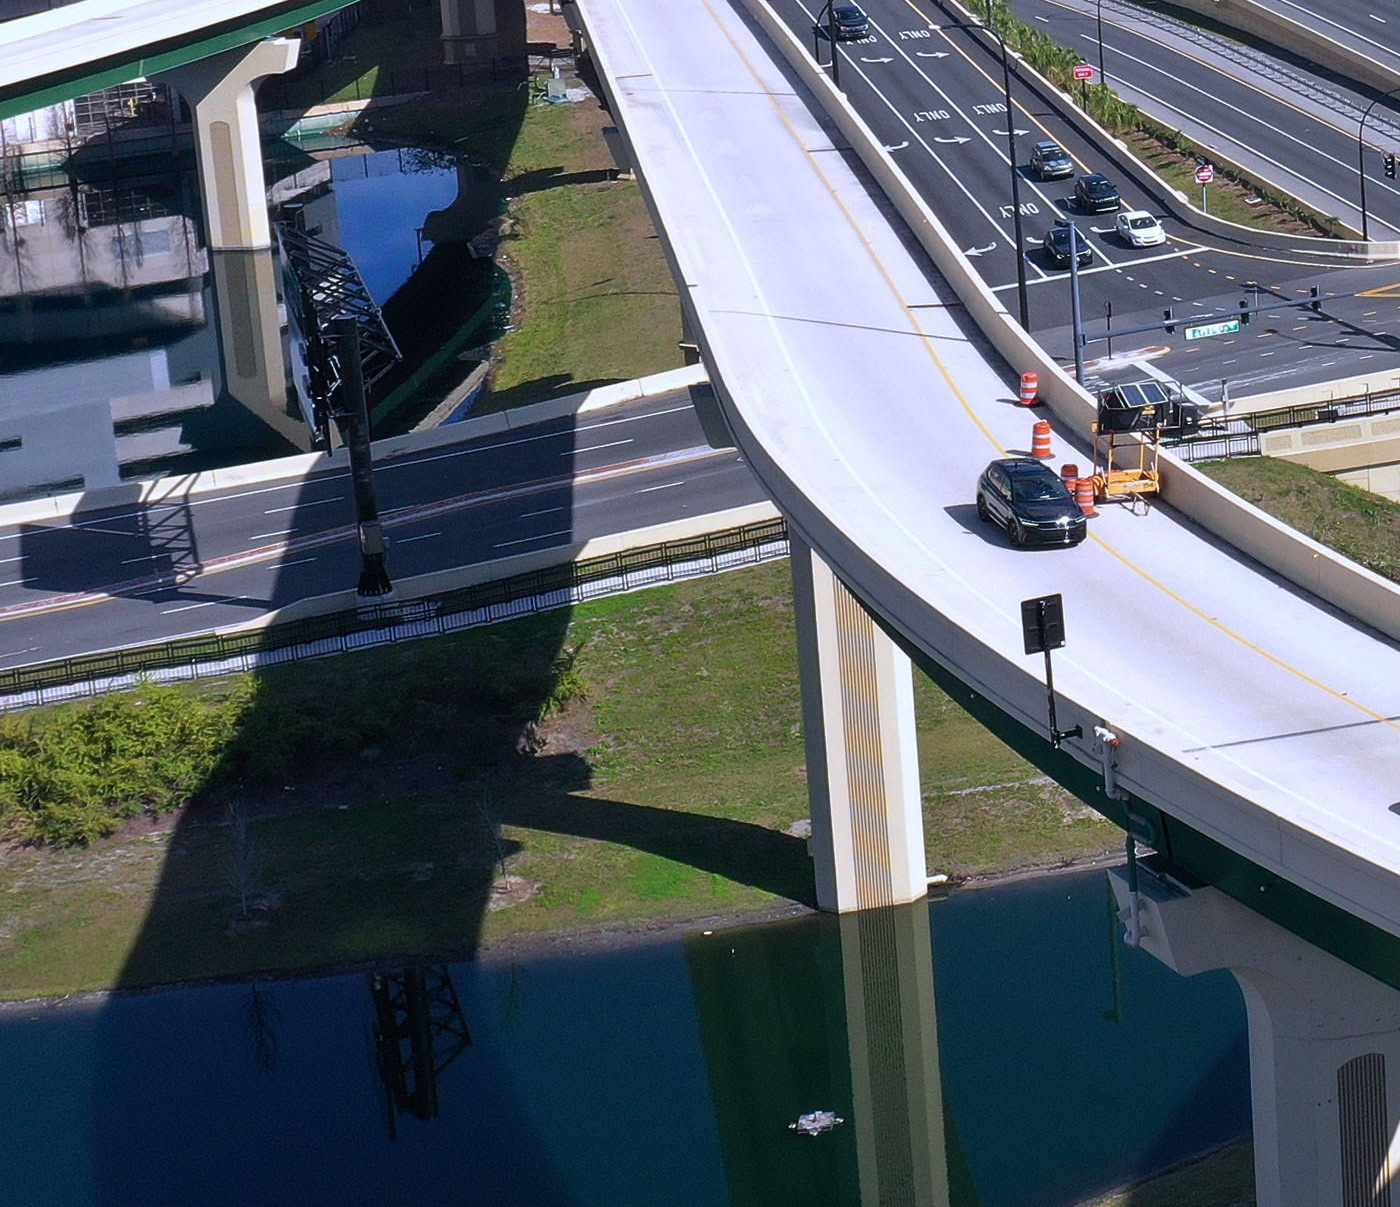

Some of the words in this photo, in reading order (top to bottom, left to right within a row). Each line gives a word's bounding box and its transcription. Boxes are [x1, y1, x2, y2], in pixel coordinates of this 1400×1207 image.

[846, 35, 877, 46] ON
[898, 29, 931, 41] ONLY
[972, 103, 1008, 115] ONLY
[913, 109, 951, 122] ONLY
[998, 202, 1040, 218] ONLY
